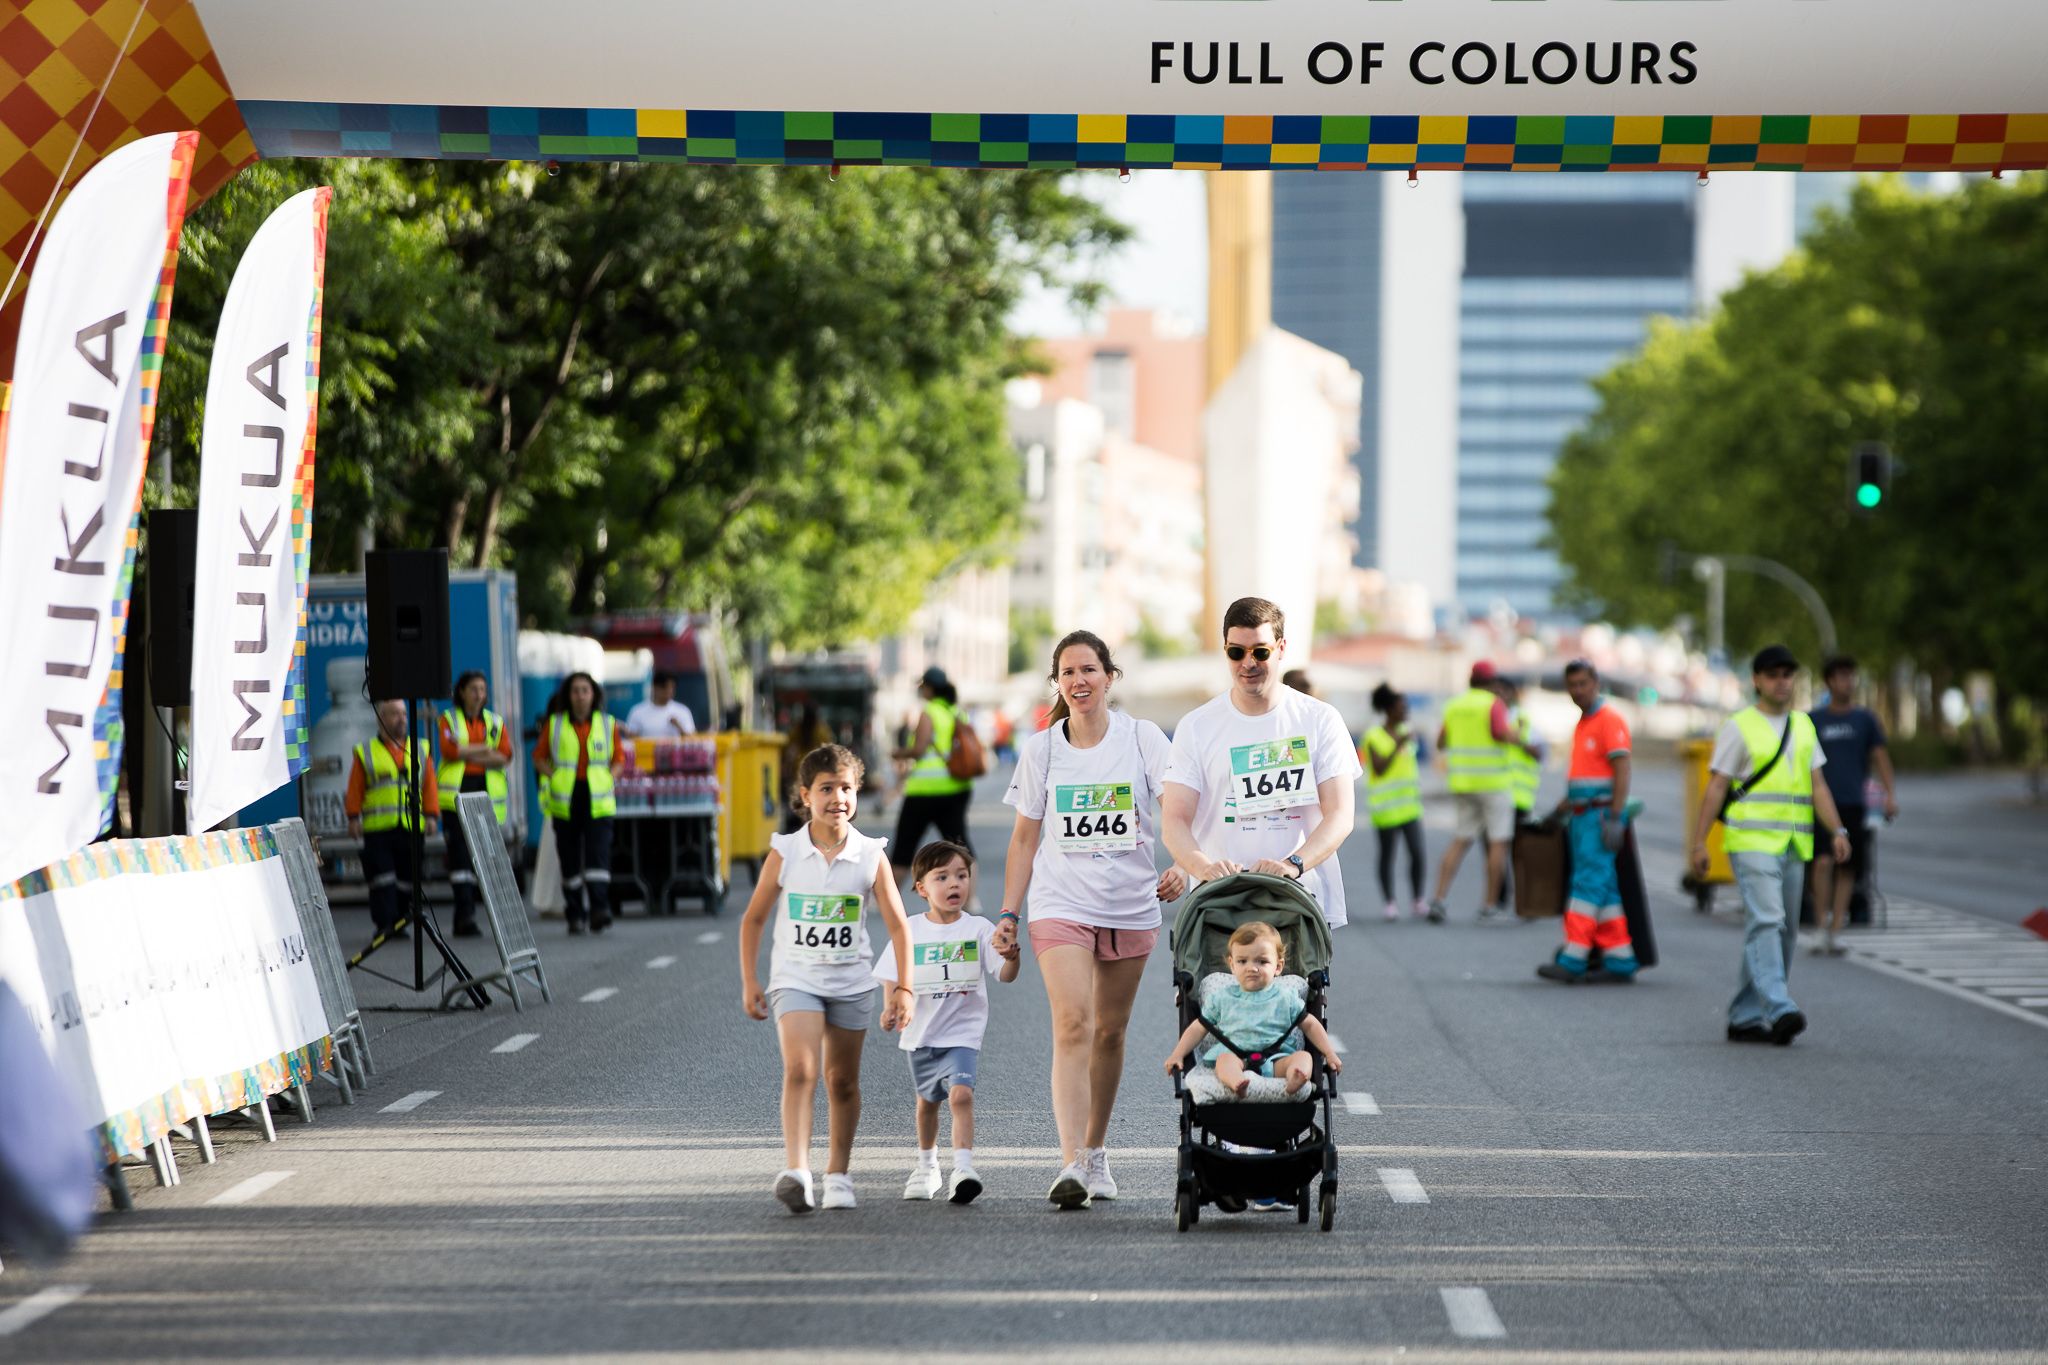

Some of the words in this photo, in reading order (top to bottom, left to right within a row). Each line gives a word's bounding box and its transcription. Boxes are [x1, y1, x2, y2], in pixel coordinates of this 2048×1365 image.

[1151, 41, 1284, 84] FULL
[1307, 41, 1385, 84] OF
[1409, 41, 1698, 85] COLOURS
[37, 309, 127, 795] MUKUA
[231, 341, 290, 751] MUKUA
[1248, 745, 1294, 770] ELA
[1242, 768, 1305, 799] 1647
[1071, 790, 1117, 810] ELA
[1063, 814, 1128, 837] 1646
[801, 900, 846, 920] ELA
[794, 925, 853, 948] 1648
[924, 944, 965, 964] ELA
[941, 964, 950, 981] 1
